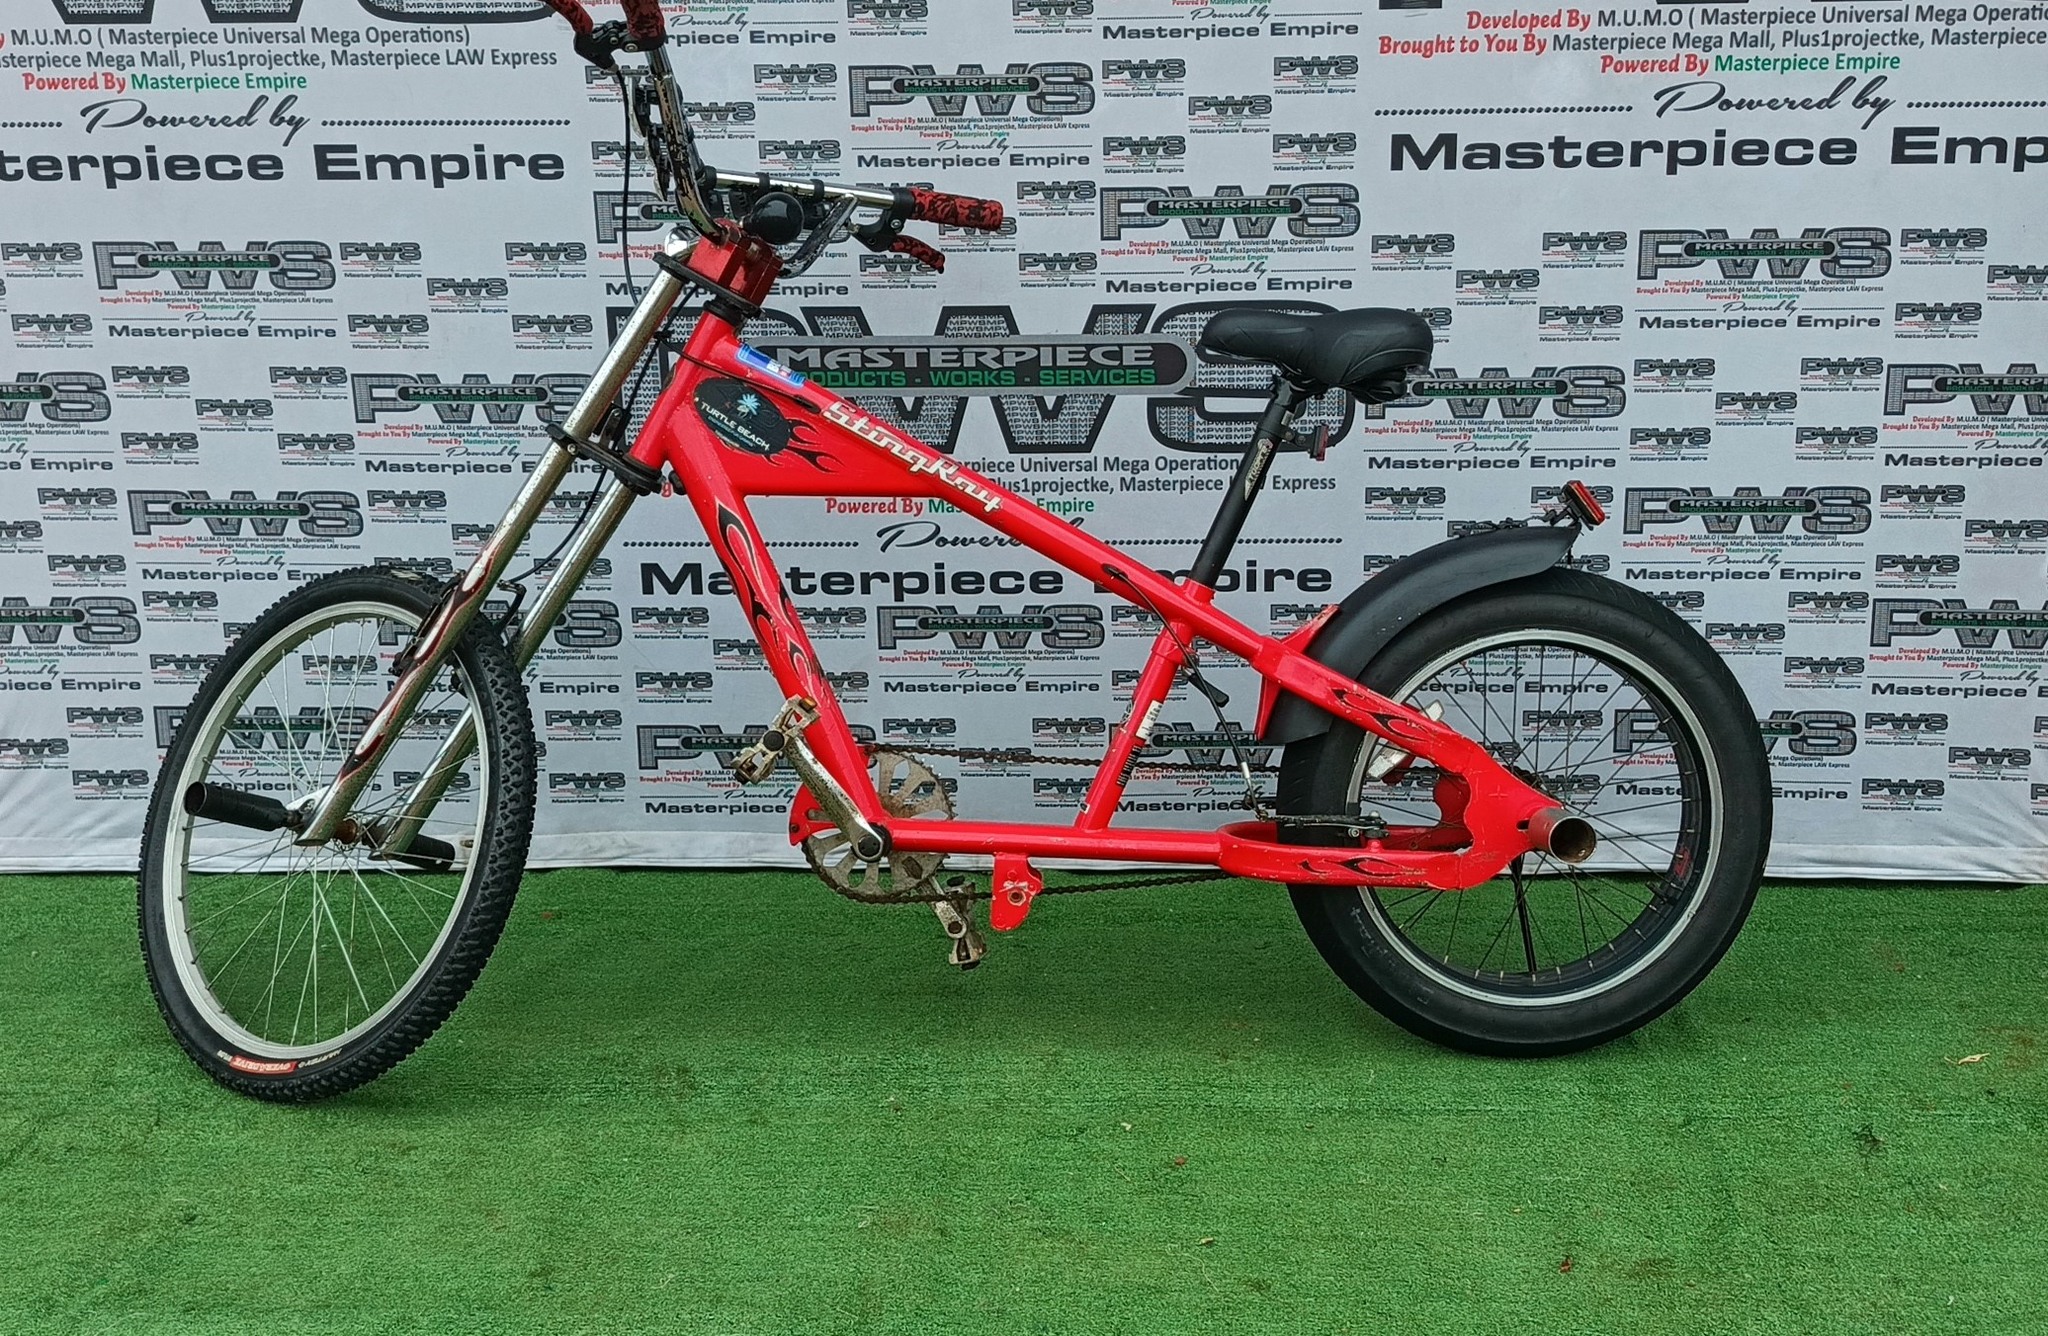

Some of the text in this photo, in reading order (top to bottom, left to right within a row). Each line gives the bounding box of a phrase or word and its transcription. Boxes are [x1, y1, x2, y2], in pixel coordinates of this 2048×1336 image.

[1466, 10, 1561, 32] Developed
[1566, 9, 1591, 31] By
[1598, 8, 1682, 27] M.U.M.O
[1701, 8, 1816, 31] Masterpiece
[1822, 4, 1909, 24] Universal
[1915, 4, 1967, 25] Mega
[1972, 3, 2048, 24] Operati
[10, 28, 92, 46] M.U.M.O
[108, 27, 218, 47] Masterpiece
[223, 26, 305, 46] Universal
[311, 26, 360, 46] Mega
[365, 25, 470, 46] Operations)
[750, 30, 836, 45] Empire
[1102, 21, 1359, 42] Masterpiece Empire
[1378, 28, 2047, 58] Brought to You By Masterpiece Mega Mall, Plus1projectke, Masterpiece
[0, 48, 558, 70] sterpiece Mega Mall, Plus1projectke, Masterpiece LAW Express
[1600, 53, 1900, 76] Powered By Masterpiece Empire
[22, 72, 307, 94] Powered By Masterpiece Empire
[848, 62, 1095, 117] PWS
[904, 77, 1029, 86] MASTERPIECE
[1654, 76, 1896, 130] Powered by
[80, 94, 310, 146] Powered by
[974, 123, 1017, 131] Plus1projectke,
[944, 131, 952, 139] By
[936, 138, 1010, 155] Powered by
[1390, 126, 2048, 175] Masterpiece Emp
[0, 144, 564, 189] terpiece Empire
[857, 154, 1090, 169] Masterpiece Empire
[1100, 183, 1360, 240] PWS
[1158, 199, 1290, 208] MASTERPIECE
[1637, 227, 1892, 280] PWS
[1695, 241, 1824, 250] MASTERPIECE
[92, 241, 336, 290] PWS
[147, 254, 269, 262] MASTERPIECE
[1190, 262, 1268, 279] Powered by
[1106, 277, 1353, 294] Masterpiece Empire
[1639, 315, 1881, 331] Masterpiece Empire
[108, 326, 336, 339] Masterpiece Empire
[777, 345, 1155, 370] MASTERPIECE
[930, 370, 1016, 386] WORKS
[1039, 368, 1157, 385] SERVICES
[1424, 380, 1556, 389] MASTERPIECE
[351, 374, 593, 423] PWS
[409, 387, 537, 395] MASTERPIECE
[701, 402, 737, 428] TURTLE
[737, 424, 770, 450] BEACH
[365, 461, 512, 475] Masterpiece
[1020, 456, 1098, 473] Universal
[1104, 455, 1150, 474] Mega
[1155, 454, 1239, 474] Operation
[1368, 456, 1616, 471] Masterpiece Empire
[1885, 454, 2043, 468] Masterpiece
[1119, 476, 1224, 494] Masterpiece
[1273, 474, 1336, 493] Express
[826, 498, 897, 514] Powered
[902, 498, 923, 516] By
[1037, 498, 1095, 515] Empire
[1623, 486, 1871, 534] PWS
[1680, 499, 1805, 507] MASTERPIECE
[127, 490, 363, 537] PWS
[142, 569, 278, 582] Masterpiece
[640, 561, 1064, 602] Materpiece
[1626, 568, 1861, 582] Masterpiece Empire
[877, 604, 1105, 649] PWS
[61, 679, 141, 692] Empire
[884, 681, 1100, 694] Masterpiece Empire
[1871, 683, 2027, 698] Masterpiece
[1772, 787, 1848, 800] Empire
[646, 802, 787, 815] Masterpiece
